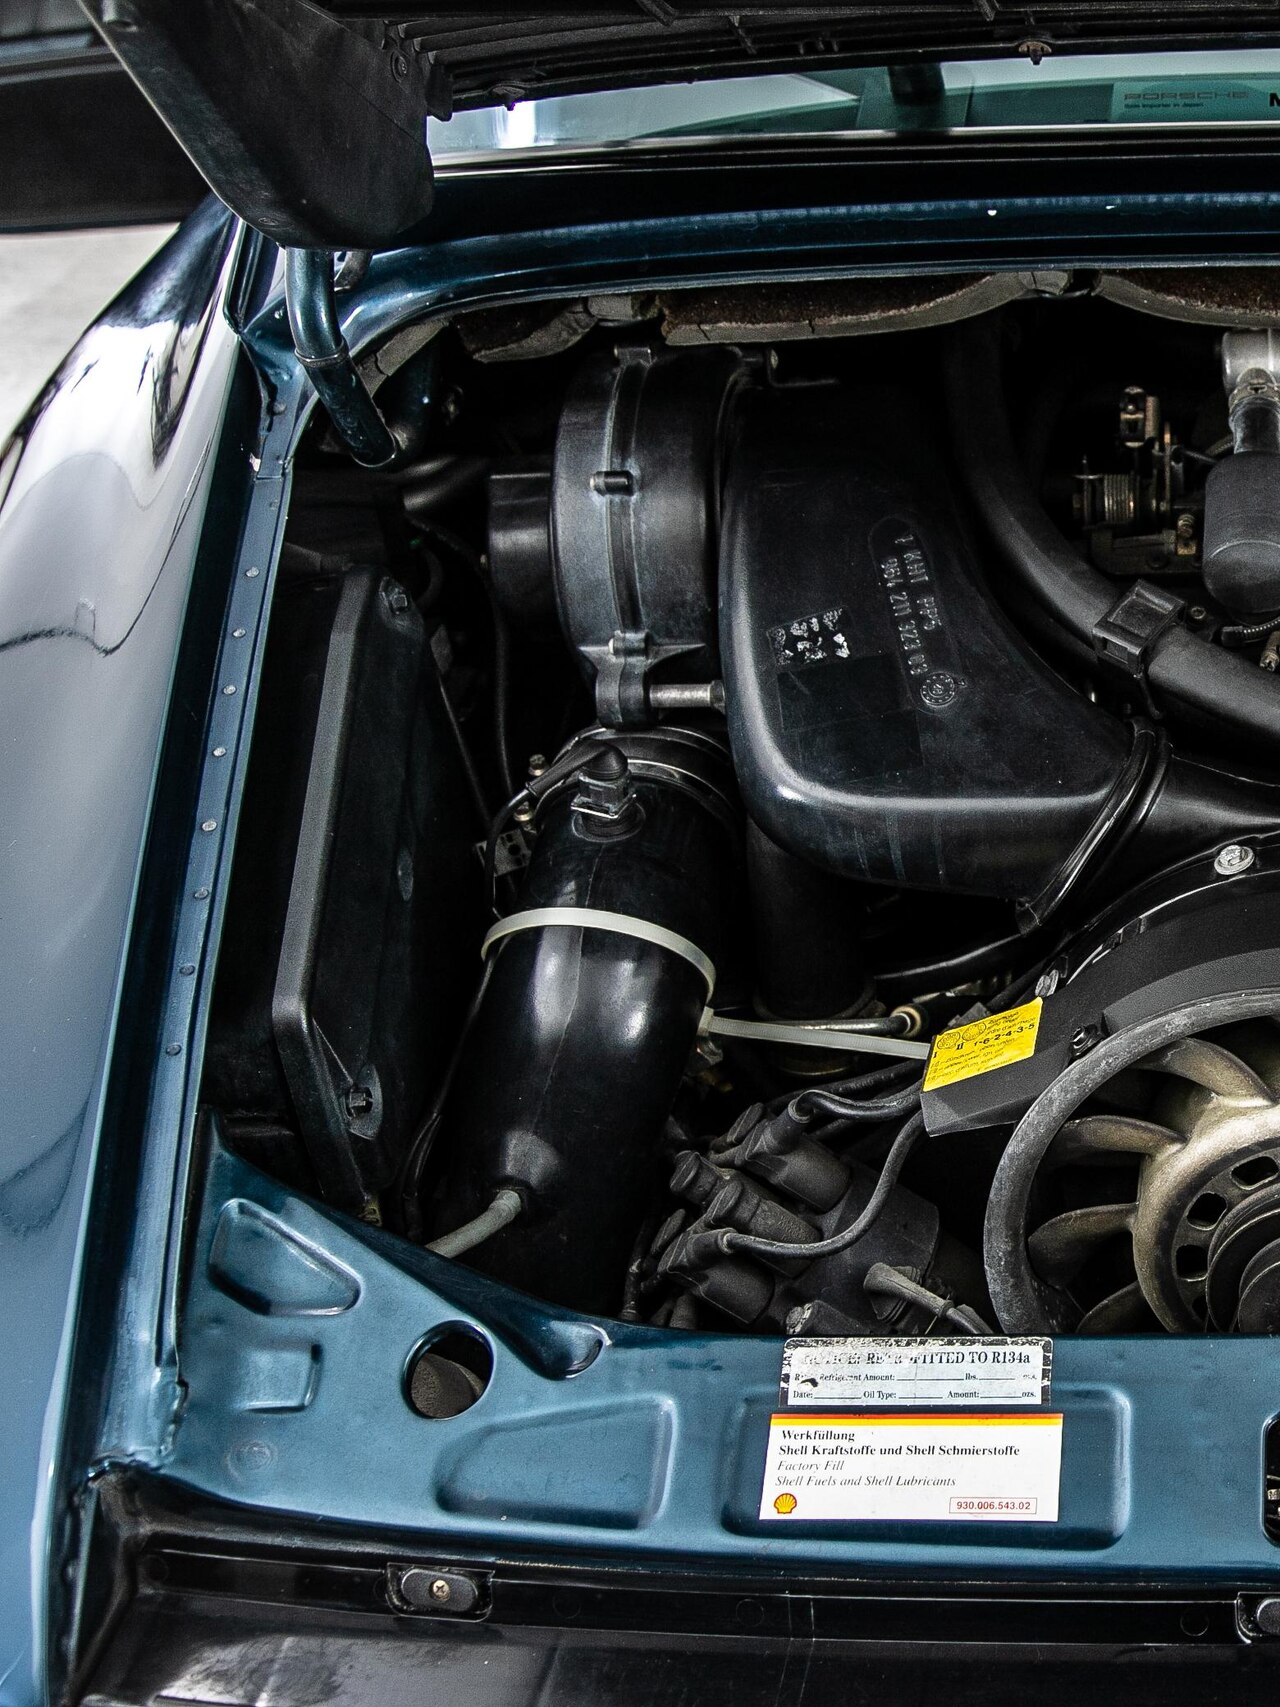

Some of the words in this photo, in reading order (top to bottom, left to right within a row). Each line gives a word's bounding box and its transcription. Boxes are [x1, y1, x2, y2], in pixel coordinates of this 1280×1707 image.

[968, 1352, 988, 1364] TO
[991, 1351, 1031, 1364] R134a
[793, 1391, 814, 1399] Date:
[863, 1391, 875, 1399] Oil
[876, 1391, 897, 1400] Type:
[946, 1391, 980, 1399] Amount:
[782, 1430, 855, 1443] Werkfüllung
[778, 1445, 808, 1456] Shell
[811, 1445, 876, 1456] Kraftstoffe
[879, 1445, 903, 1456] und
[905, 1445, 935, 1456] Shell
[938, 1445, 1020, 1456] Schmierstoffe
[777, 1460, 820, 1473] Factory
[824, 1460, 845, 1471] Fill
[775, 1475, 804, 1487] Shell
[806, 1475, 837, 1487] Fuels
[839, 1475, 862, 1487] and
[864, 1475, 893, 1487] Shell
[895, 1475, 956, 1487] Lubricants
[956, 1501, 1031, 1510] 930.006.543.02
